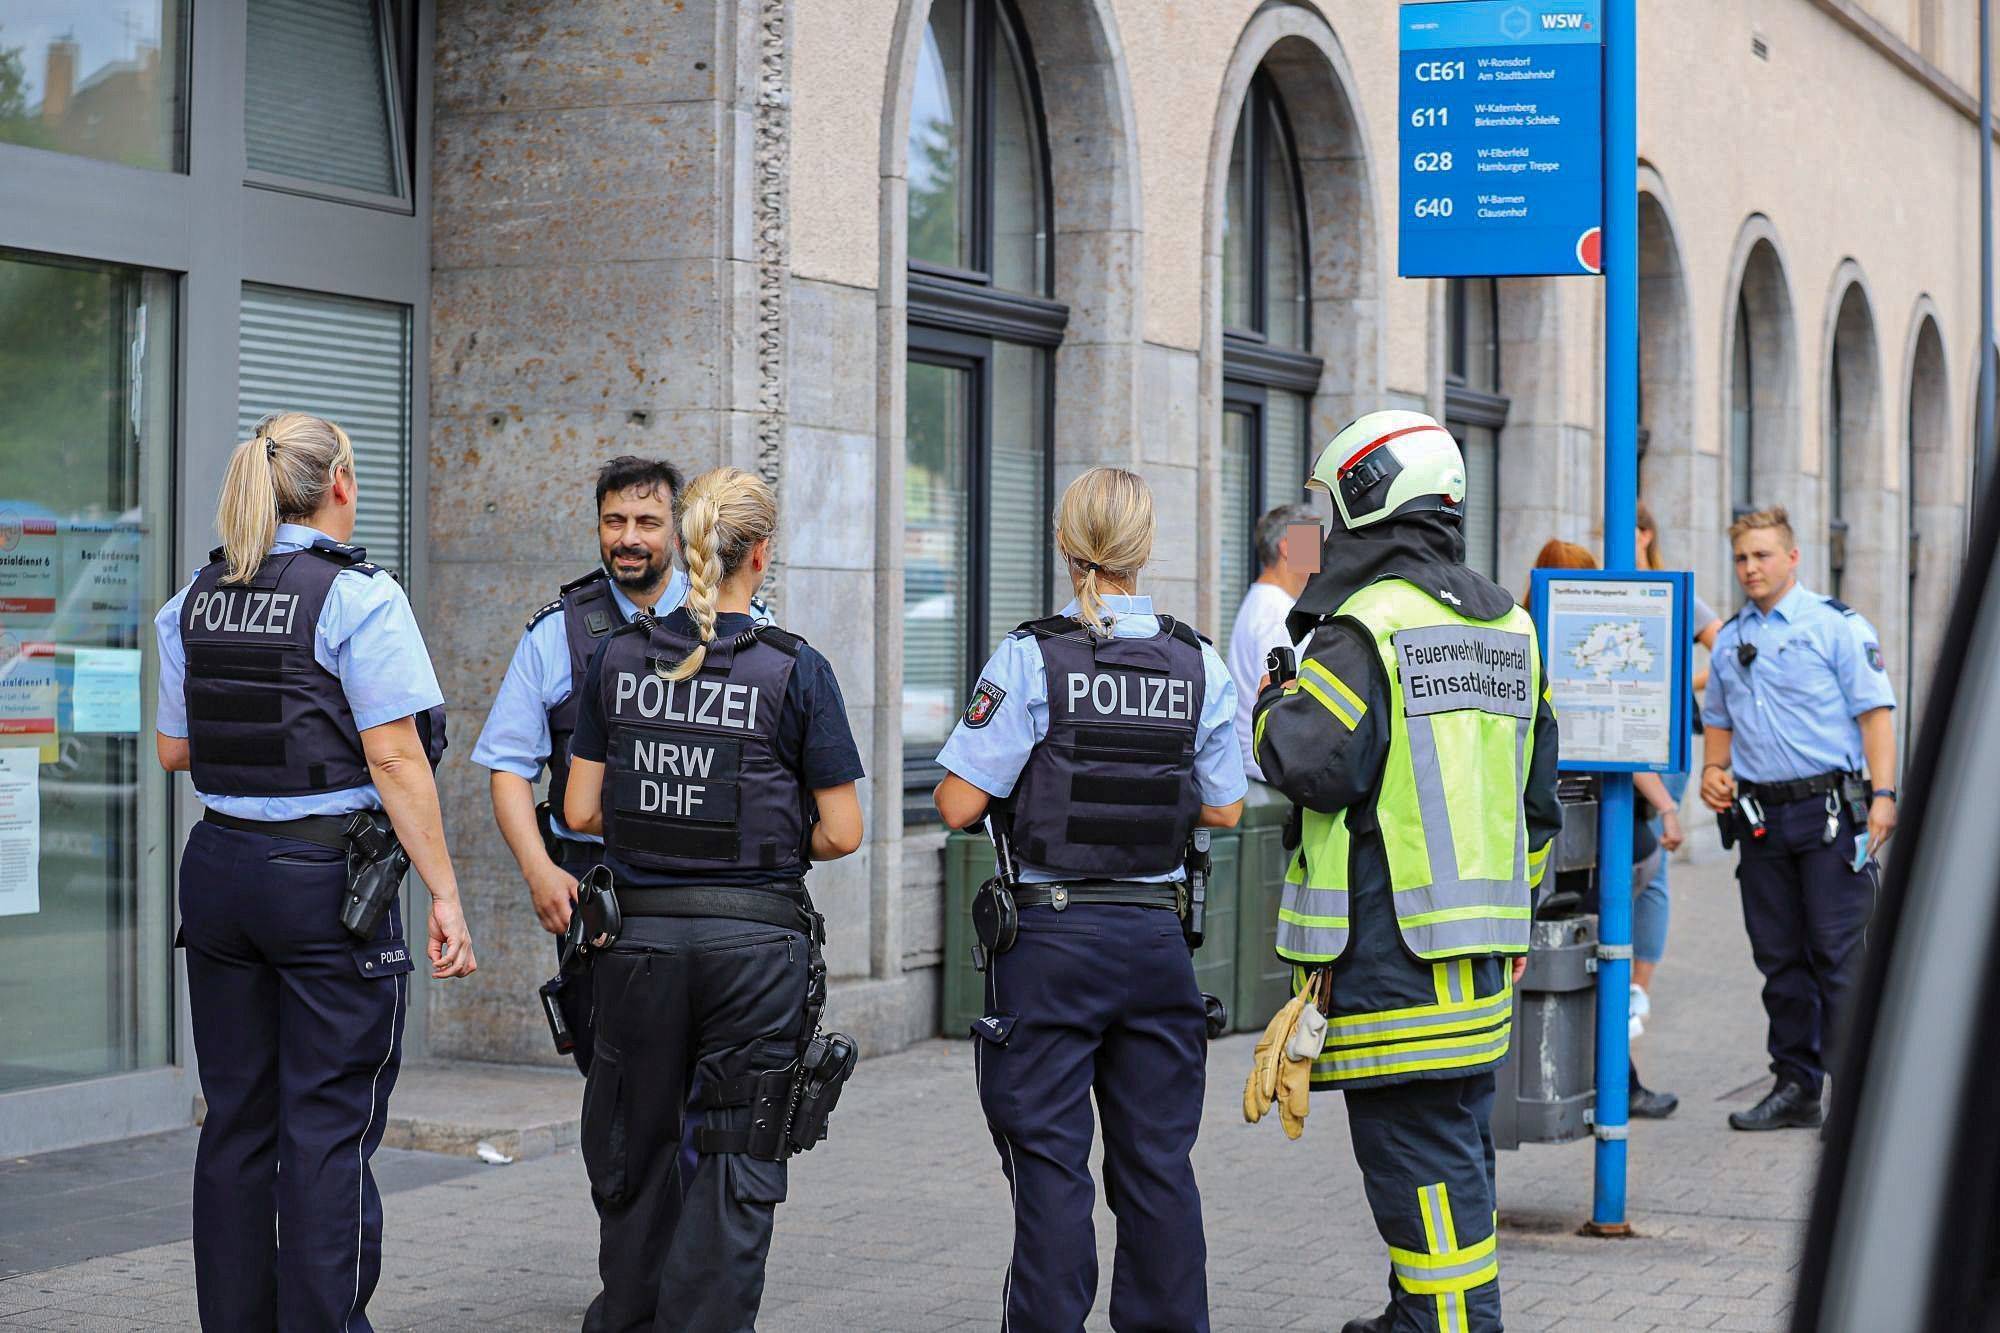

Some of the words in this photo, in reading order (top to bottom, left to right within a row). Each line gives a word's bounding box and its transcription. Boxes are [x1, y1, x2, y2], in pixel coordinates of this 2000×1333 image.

[1415, 61, 1465, 82] CE61
[1477, 57, 1530, 68] W-Ronsdorf
[1477, 71, 1493, 81] Am
[1496, 69, 1555, 80] Stadtbahnhof
[1411, 107, 1449, 127] 611
[1474, 116, 1523, 127] Birkenhöhe
[1526, 115, 1560, 126] Schleife
[1413, 152, 1453, 171] 628
[1477, 148, 1529, 158] W-Elberfeld
[1477, 162, 1527, 172] Hamburger
[1529, 161, 1560, 172] Treppe
[1414, 197, 1453, 218] 640
[1477, 195, 1525, 205] W-Barmen
[1477, 207, 1528, 218] Clausenhof
[44, 557, 50, 567] 6
[102, 564, 119, 573] und
[93, 575, 128, 585] Wohnen
[189, 591, 299, 634] POLIZEI
[1474, 641, 1526, 672] Wuppertal
[1068, 672, 1193, 720] POLIZEI
[1411, 672, 1527, 701] Einsatleiter-B
[616, 672, 759, 729] POLIZEI
[634, 739, 714, 778] NRW
[640, 780, 705, 816] DHF
